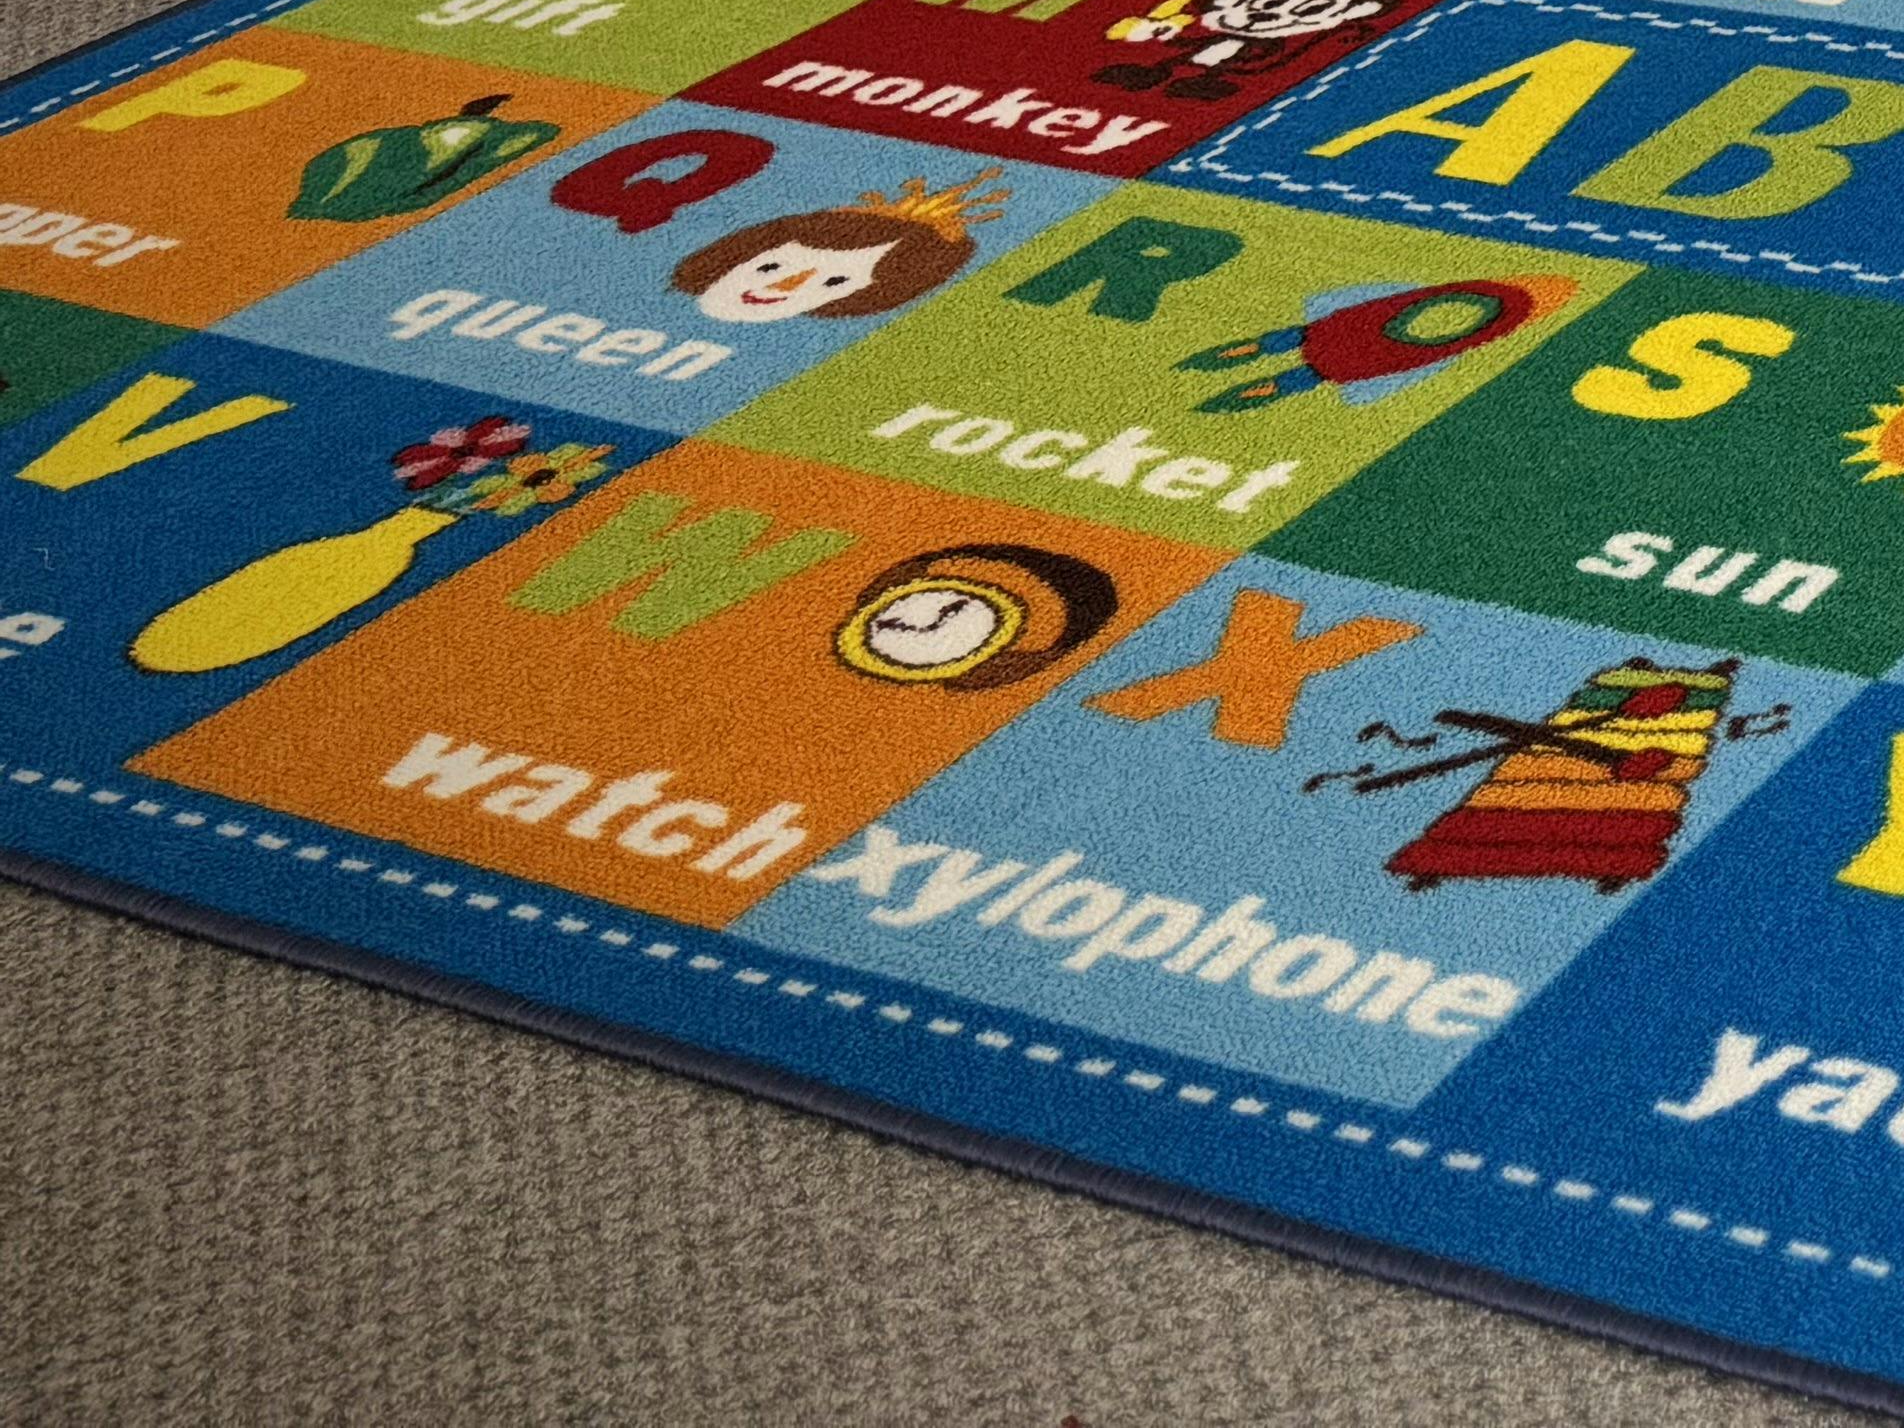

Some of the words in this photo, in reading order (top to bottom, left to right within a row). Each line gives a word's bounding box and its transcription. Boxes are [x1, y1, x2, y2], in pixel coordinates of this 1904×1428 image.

[76, 58, 306, 133] P
[762, 60, 1172, 155] monkey
[549, 128, 775, 234] Q
[1000, 214, 1245, 324] R
[388, 288, 737, 382] queen
[1571, 310, 1796, 419] S
[14, 370, 295, 491] V
[865, 396, 1303, 517] rocket
[504, 490, 860, 642] W
[1575, 528, 1840, 615] sun
[1079, 588, 1429, 749] X
[379, 731, 812, 882] watch
[810, 828, 1523, 1044] xylophone
